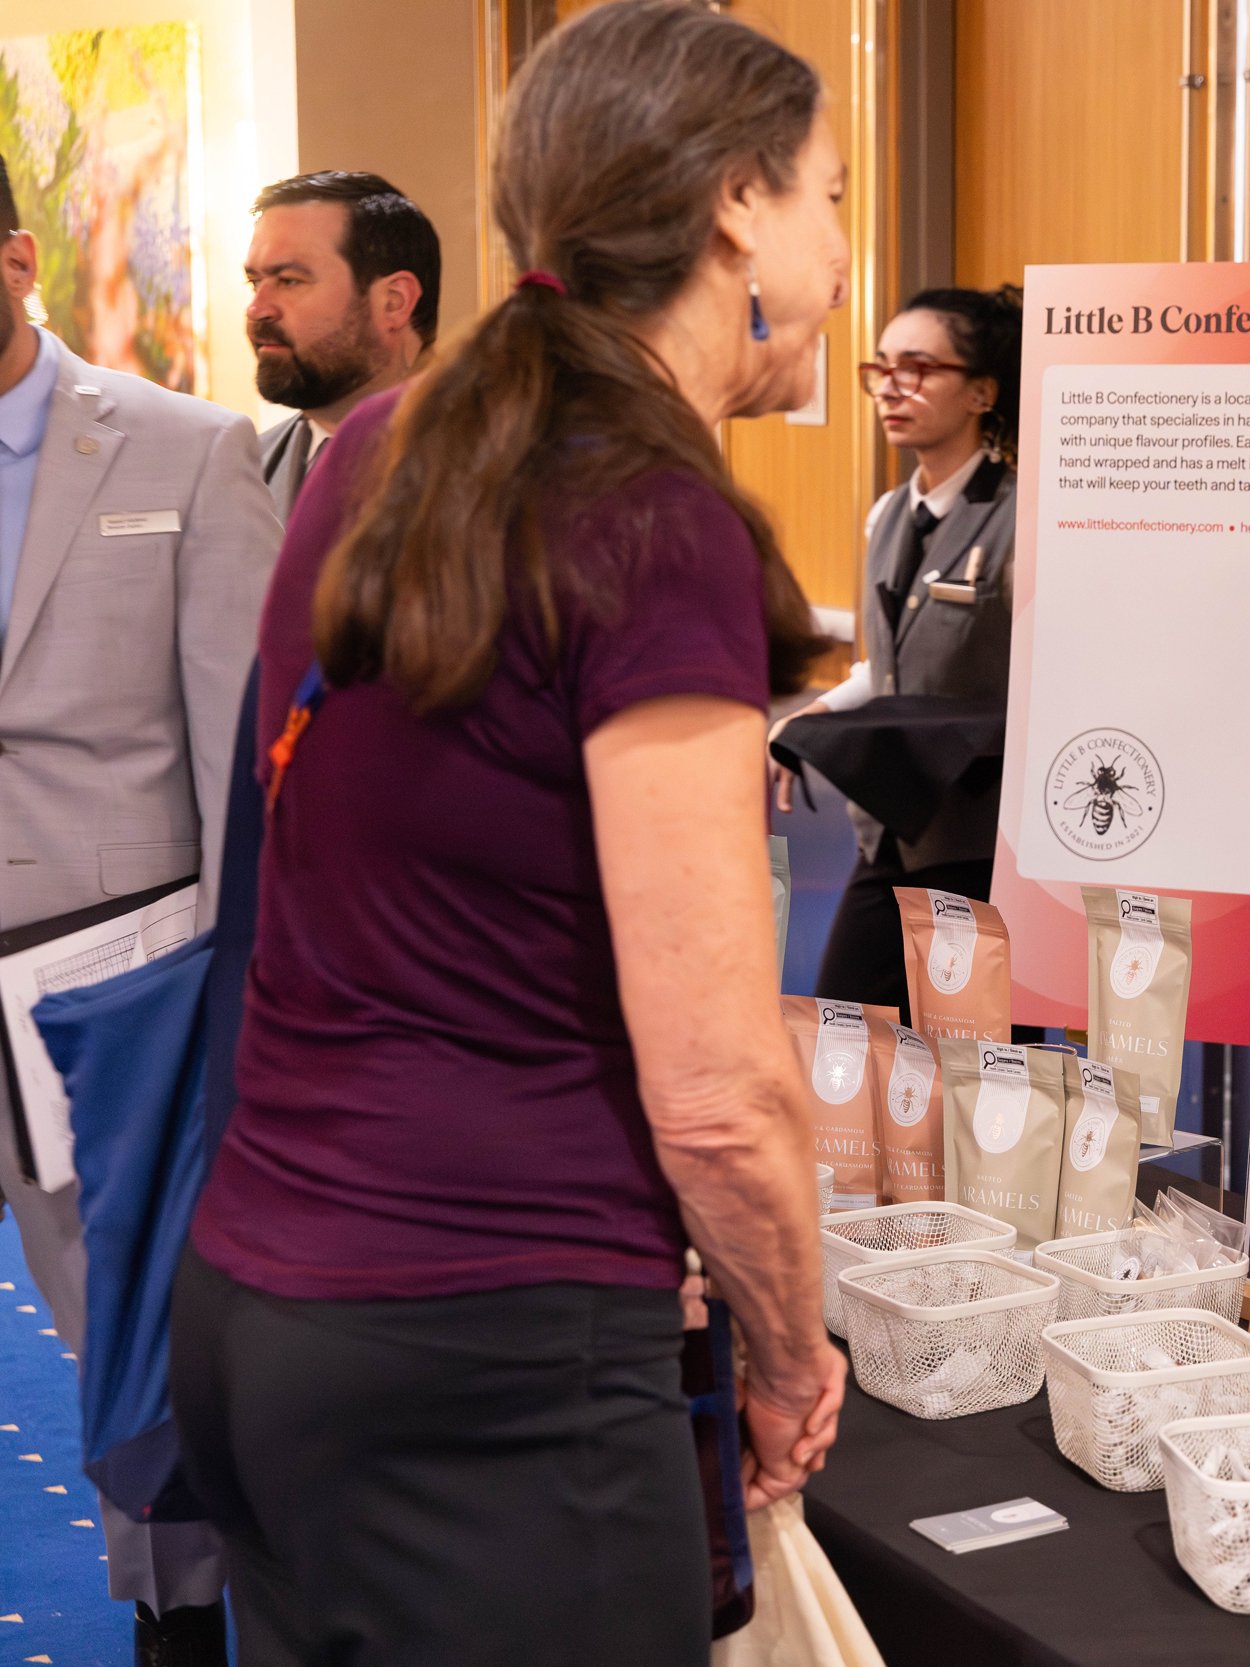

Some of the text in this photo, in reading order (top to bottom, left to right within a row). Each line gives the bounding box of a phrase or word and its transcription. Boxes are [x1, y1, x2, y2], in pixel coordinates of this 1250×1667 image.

[1045, 305, 1124, 335] Little
[1131, 305, 1153, 334] B
[1061, 391, 1092, 405] Little
[1095, 391, 1104, 405] B
[1106, 391, 1198, 409] Confectionery
[1200, 391, 1211, 405] is
[1213, 394, 1221, 405] a
[1060, 415, 1119, 429] company
[1121, 412, 1147, 426] that
[1149, 412, 1220, 429] specializes
[1222, 413, 1234, 427] in
[1059, 433, 1086, 447] with
[1089, 434, 1133, 450] unique
[1135, 433, 1179, 448] flavour
[1181, 434, 1233, 451] profiles.
[1059, 454, 1091, 469] hand
[1093, 455, 1150, 472] wrapped
[1152, 455, 1177, 470] and
[1180, 455, 1203, 470] has
[1205, 459, 1213, 470] a
[1216, 456, 1246, 471] melt
[1058, 475, 1083, 490] that
[1085, 476, 1106, 489] will
[1108, 476, 1140, 493] keep
[1142, 480, 1171, 494] your
[1173, 477, 1207, 492] teeth
[1210, 478, 1235, 492] and
[1058, 519, 1223, 534] www.littlebconfectionery.com
[1054, 737, 1157, 798] LITTLE B CONFECTIONERY
[1060, 821, 1112, 850] ESTABLISHED
